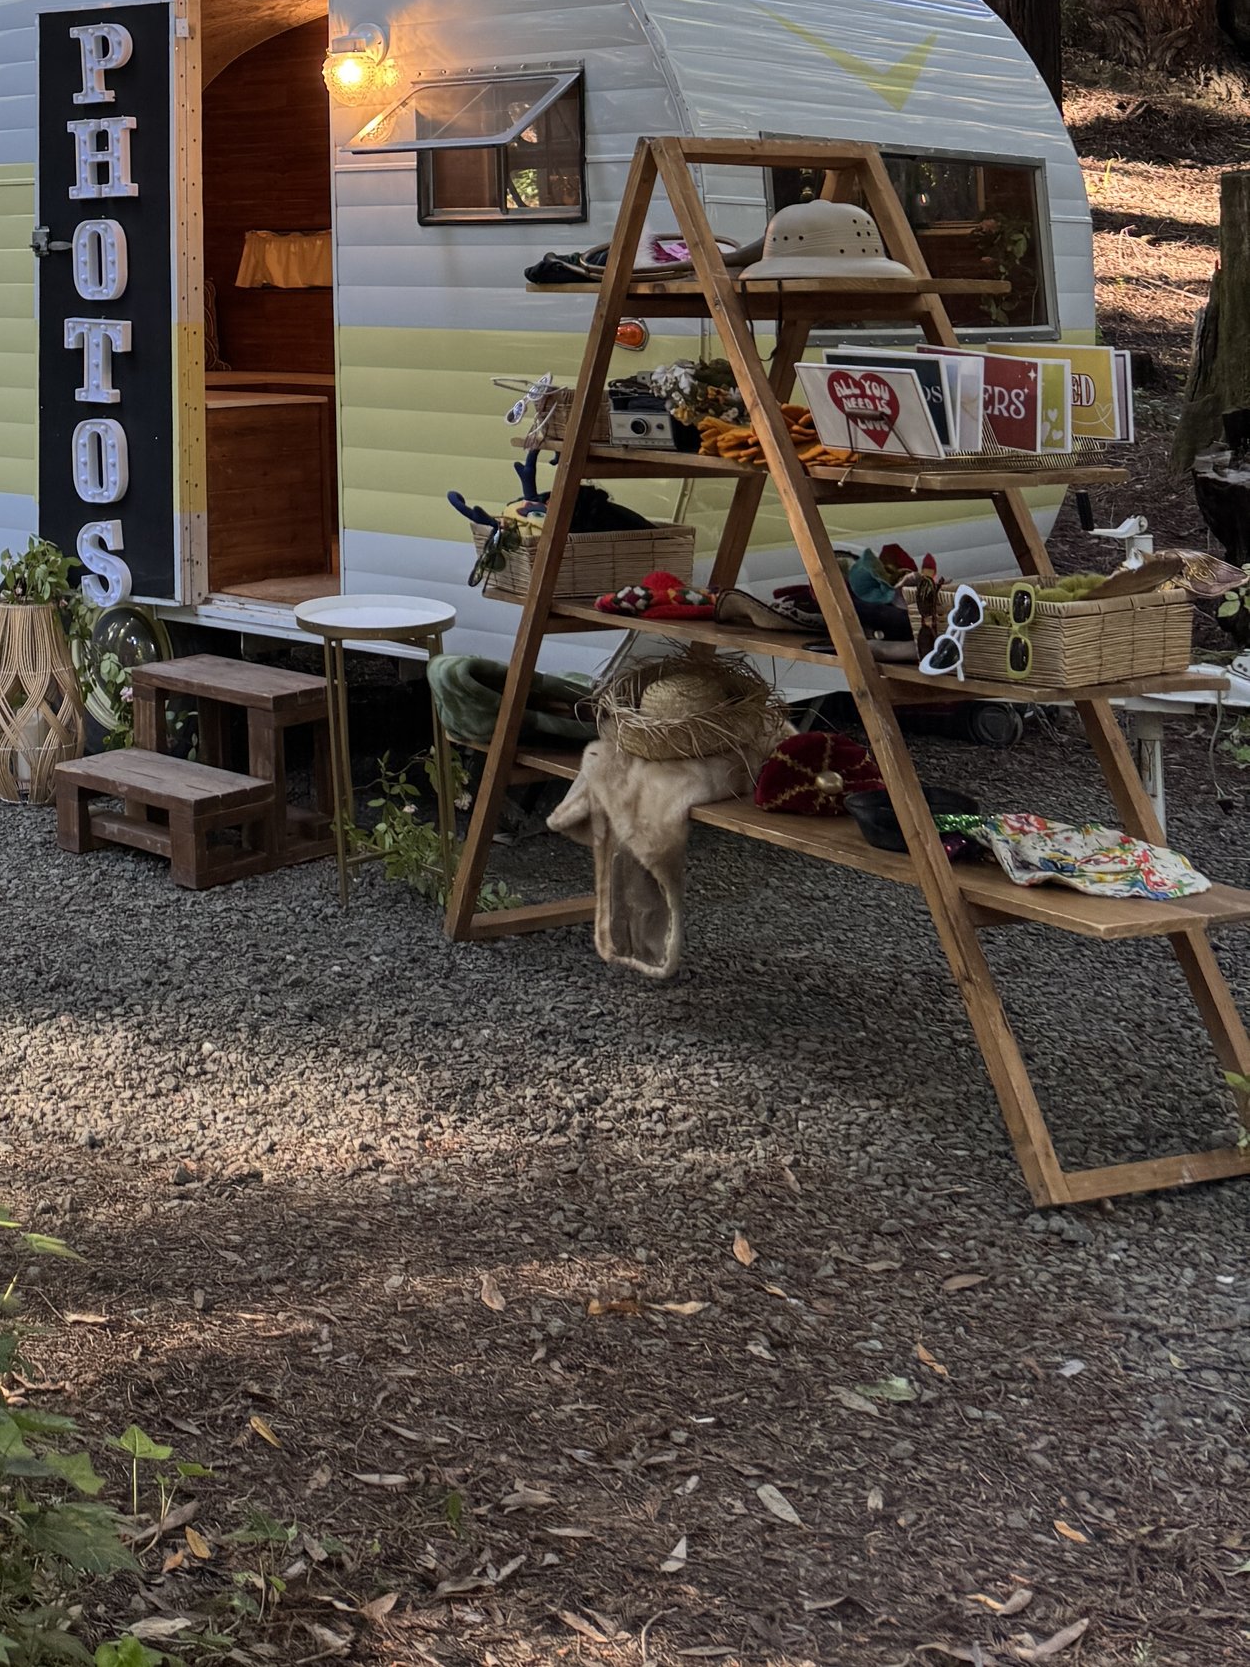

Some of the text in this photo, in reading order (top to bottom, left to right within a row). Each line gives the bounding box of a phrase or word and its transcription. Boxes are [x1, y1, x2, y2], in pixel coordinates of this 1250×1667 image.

[63, 22, 139, 608] PHOTOS
[833, 378, 890, 400] ALL YOU
[842, 397, 892, 414] NEED IS
